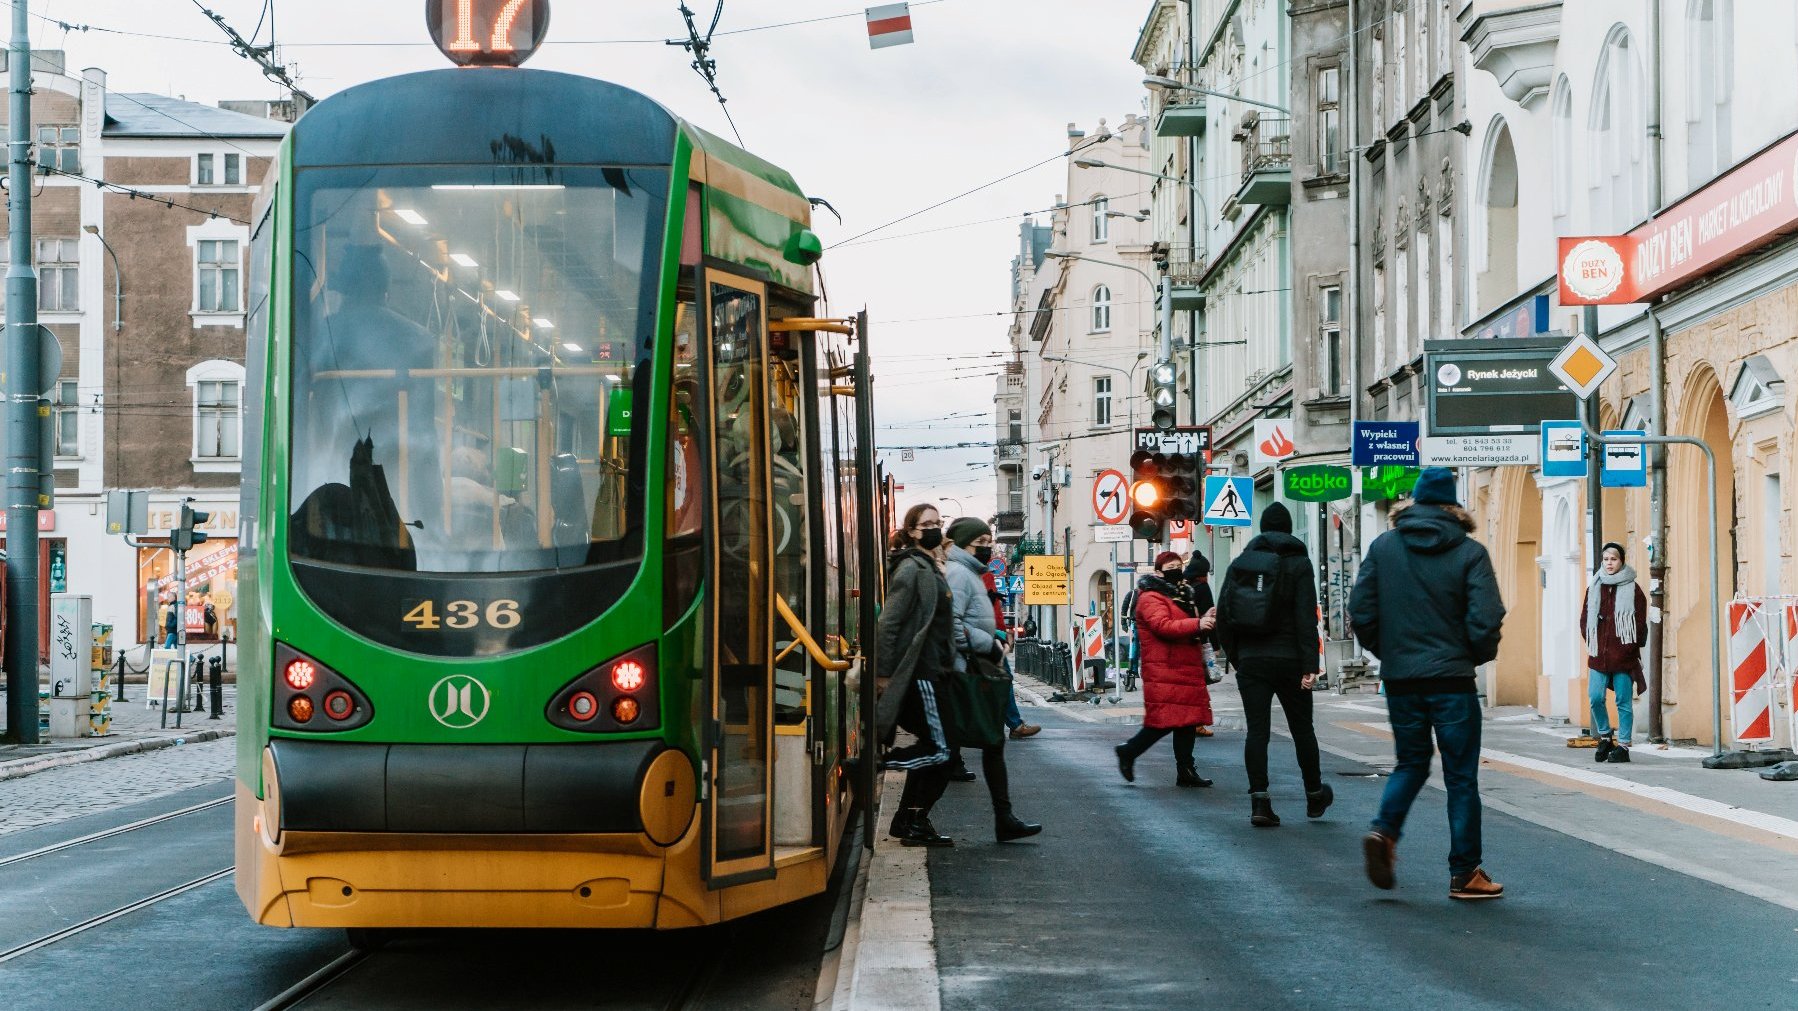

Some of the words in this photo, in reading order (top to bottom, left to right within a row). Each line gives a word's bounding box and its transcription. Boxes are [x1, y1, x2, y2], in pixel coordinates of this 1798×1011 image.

[449, 0, 526, 50] 17
[1670, 216, 1693, 268] BEN
[1699, 203, 1728, 244] MARKET
[1730, 170, 1784, 227] ALKOHOLOWY
[1582, 267, 1609, 280] BEN
[1467, 369, 1499, 382] Rynek
[1500, 368, 1538, 381] Jeżycki
[1361, 429, 1397, 441] Wypieki
[1376, 441, 1410, 452] własnej
[1374, 452, 1415, 463] pracowni
[1430, 454, 1529, 462] www.kancelariagazda.pl
[1290, 473, 1347, 490] żabka
[403, 599, 521, 629] 436
